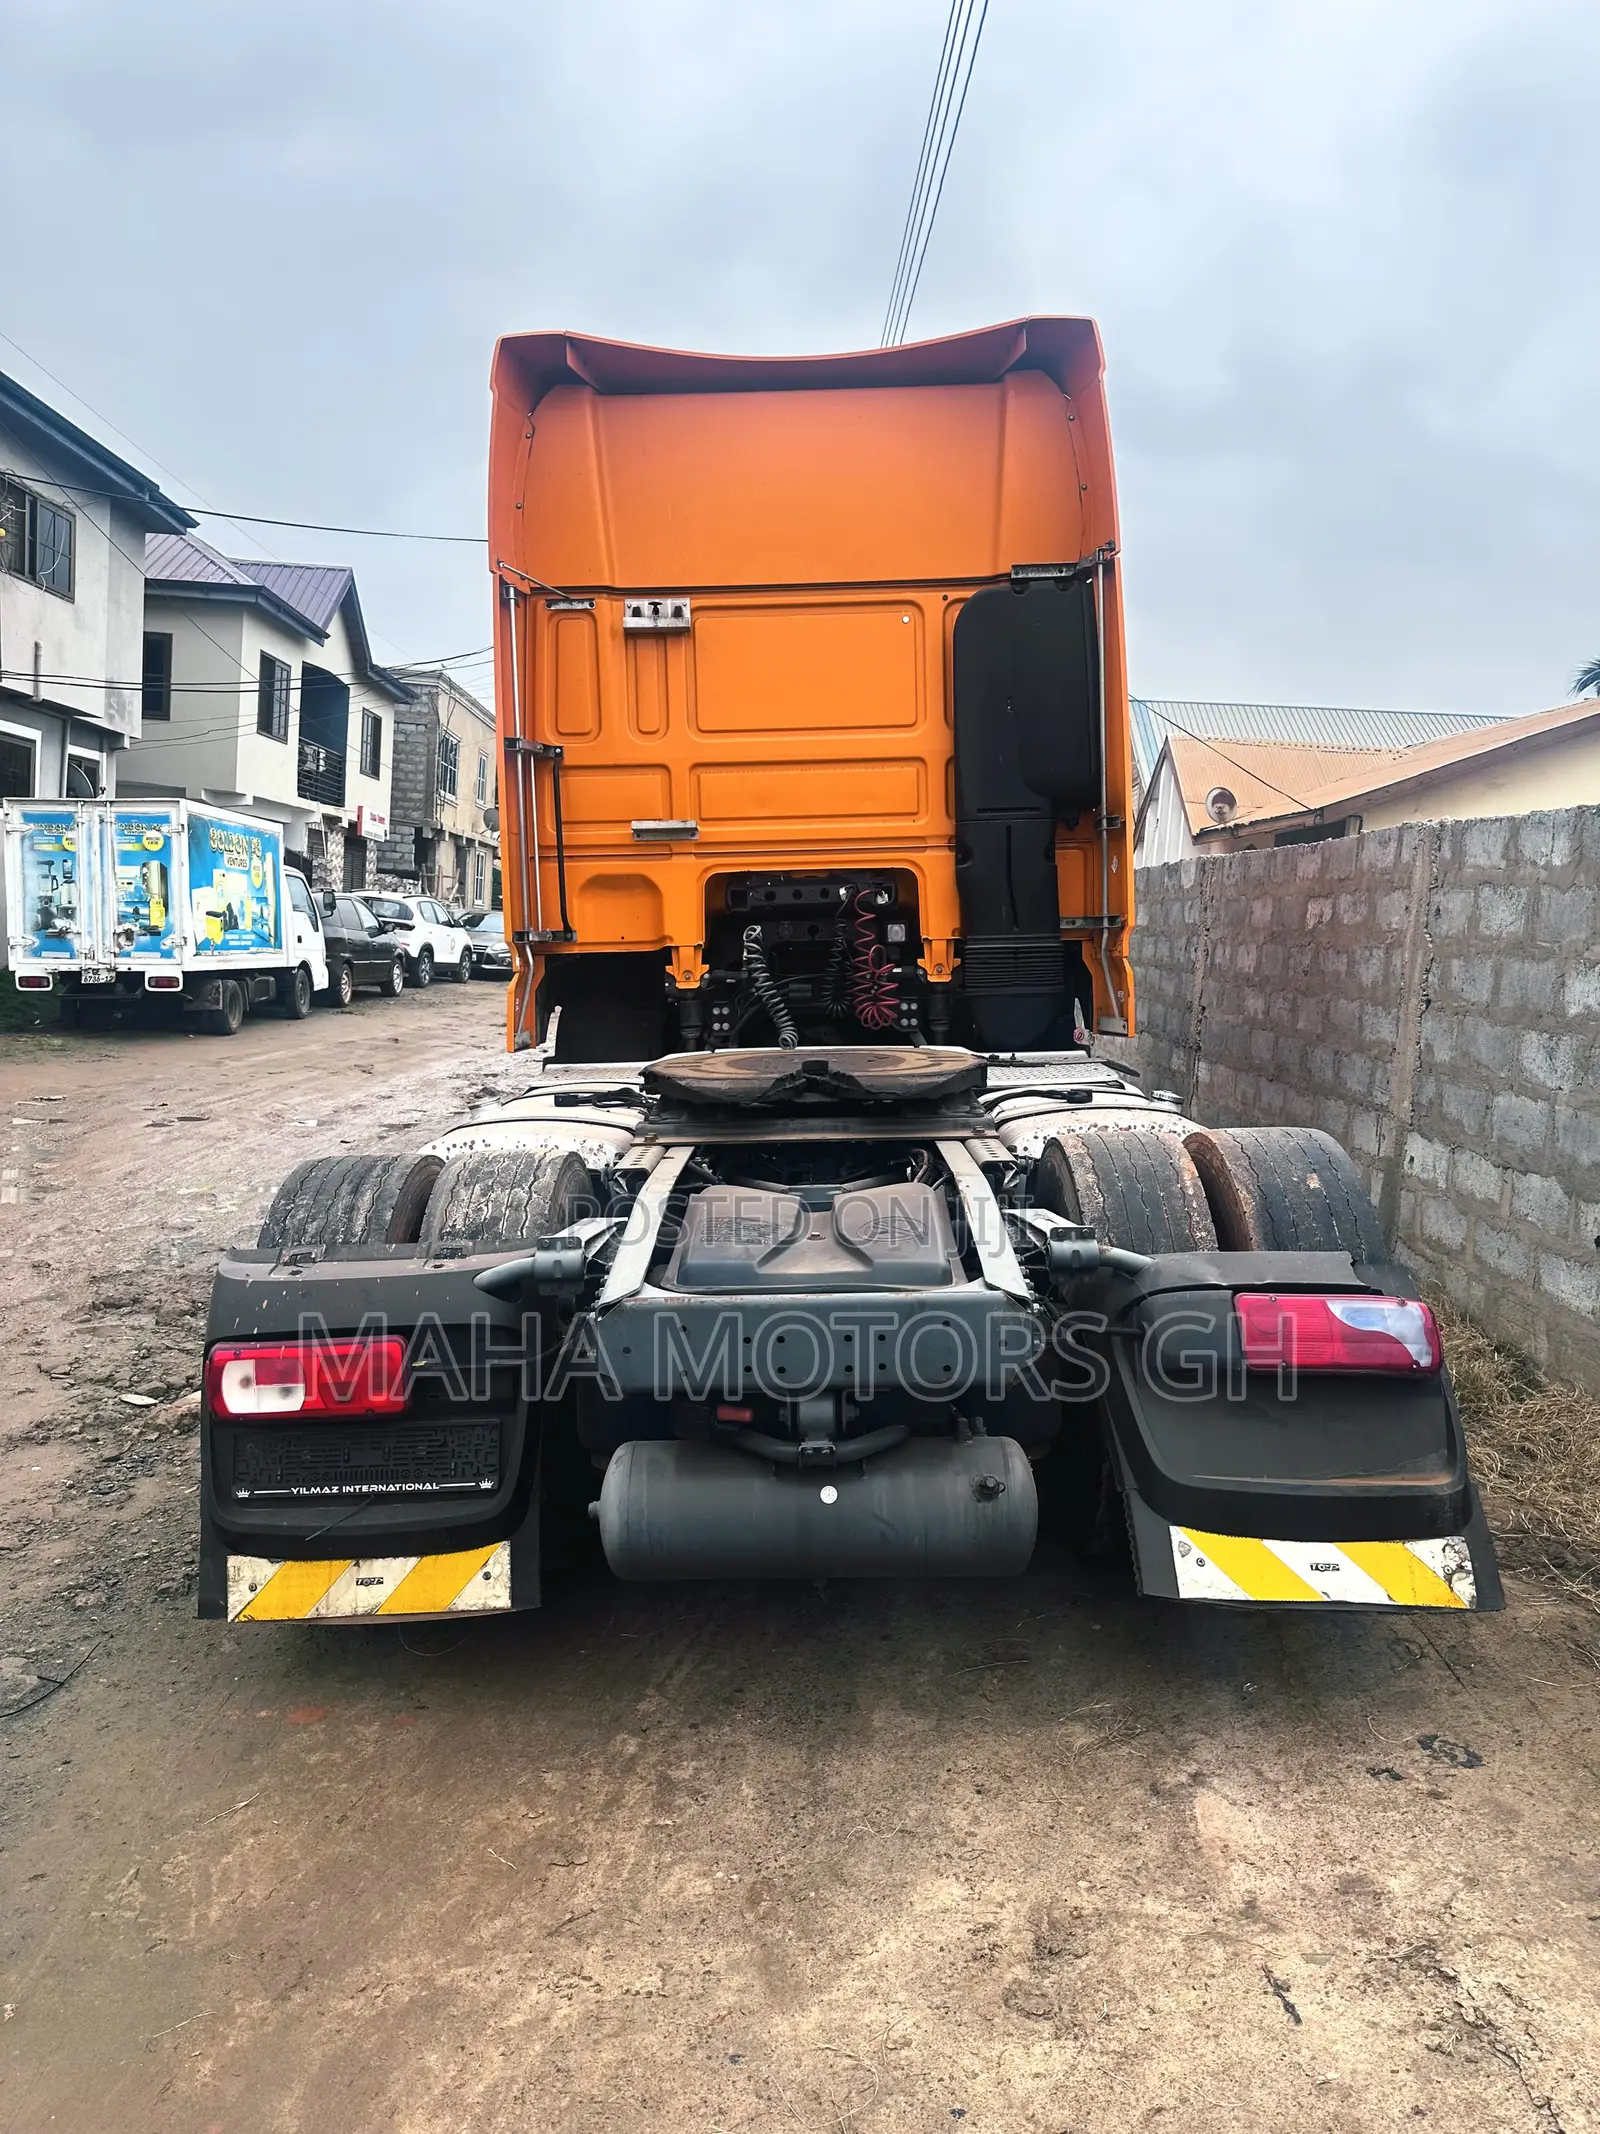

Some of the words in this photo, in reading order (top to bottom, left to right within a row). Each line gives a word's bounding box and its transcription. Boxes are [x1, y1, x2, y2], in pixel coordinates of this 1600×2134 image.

[226, 856, 249, 869] VENTURES
[291, 1485, 340, 1495] YILMAZ
[342, 1482, 440, 1493] INTERNATIONAL
